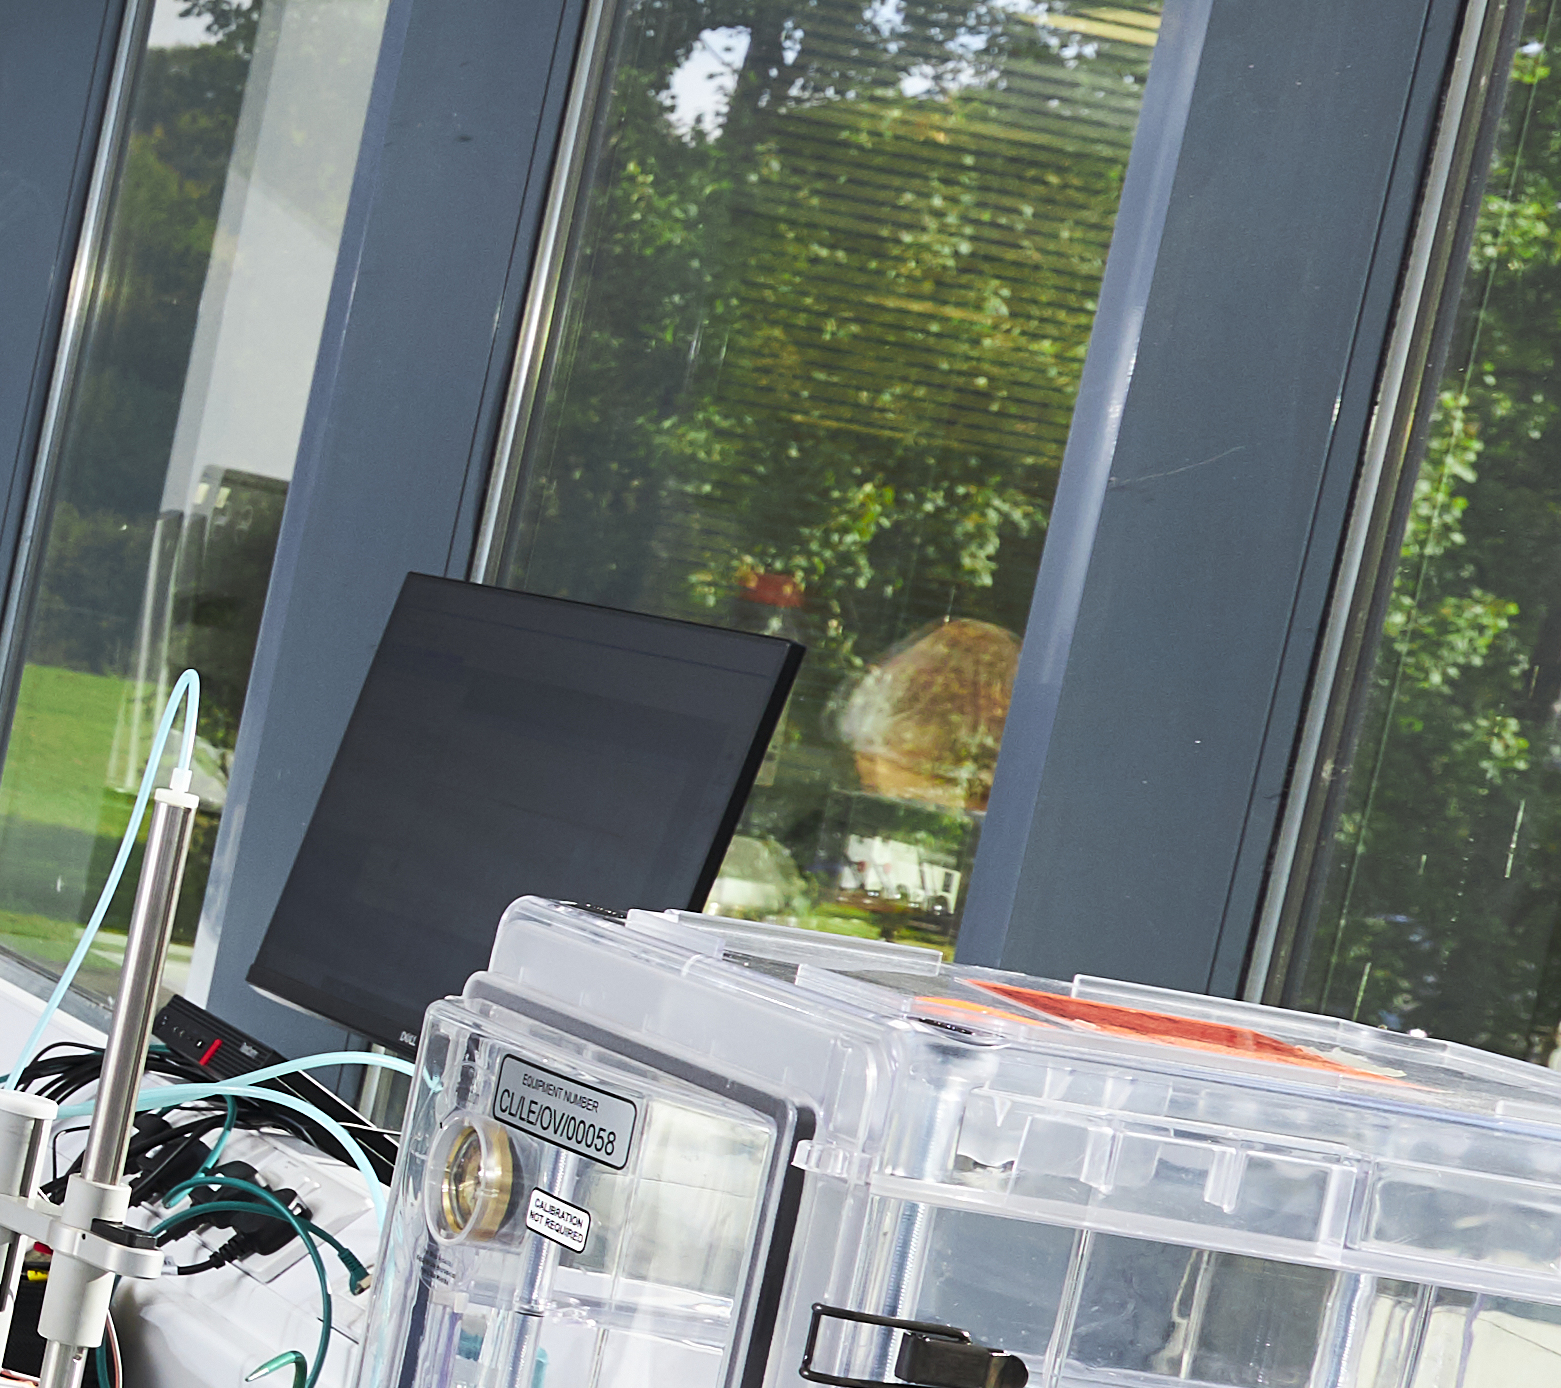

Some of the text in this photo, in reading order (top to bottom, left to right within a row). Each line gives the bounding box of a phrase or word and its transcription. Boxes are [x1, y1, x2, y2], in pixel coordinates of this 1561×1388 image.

[522, 1073, 599, 1113] EQUIPMENT NUMBER
[499, 1088, 617, 1156] CL/LE/OV/00058
[530, 1209, 584, 1243] NOT REQUIRED
[535, 1198, 584, 1228] CALIBRATION
